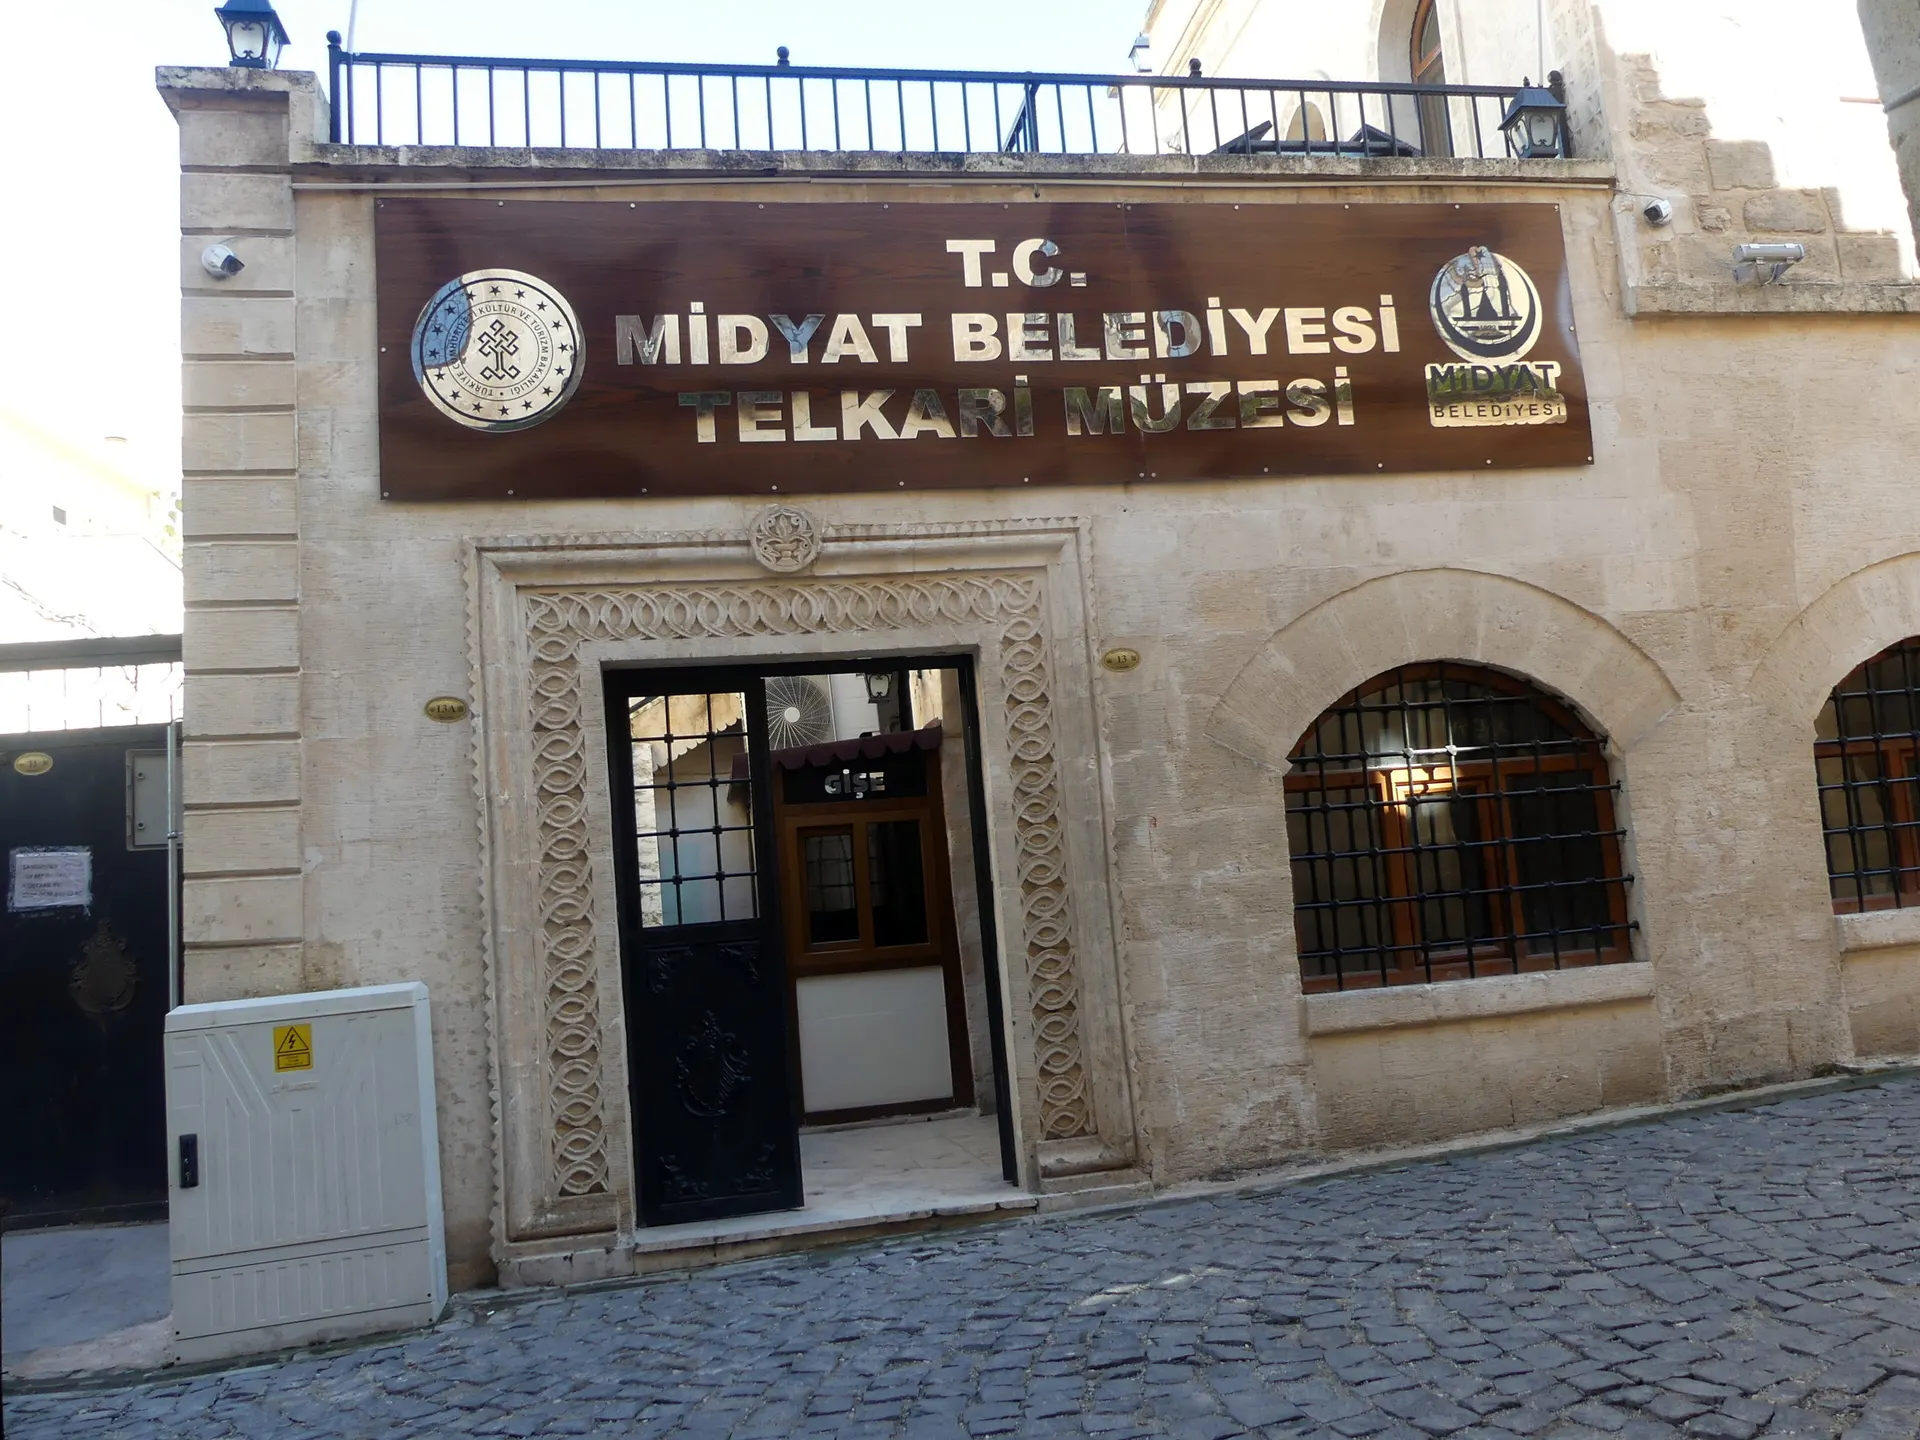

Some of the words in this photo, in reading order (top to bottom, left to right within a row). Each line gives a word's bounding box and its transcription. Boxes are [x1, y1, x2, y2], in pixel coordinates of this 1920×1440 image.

[946, 238, 1088, 288] T.C.
[478, 303, 517, 315] KÜLTÜR
[519, 310, 531, 321] VE
[530, 319, 549, 354] TURİZM
[615, 302, 922, 365] MİDYAT
[951, 294, 1400, 362] BELEDİYESİ
[510, 355, 549, 396] BAKANLIĞI
[678, 375, 1034, 443] TELKARİ
[1063, 366, 1356, 437] MÜZESİ
[1116, 655, 1128, 664] 13
[824, 769, 886, 799] GİŞE
